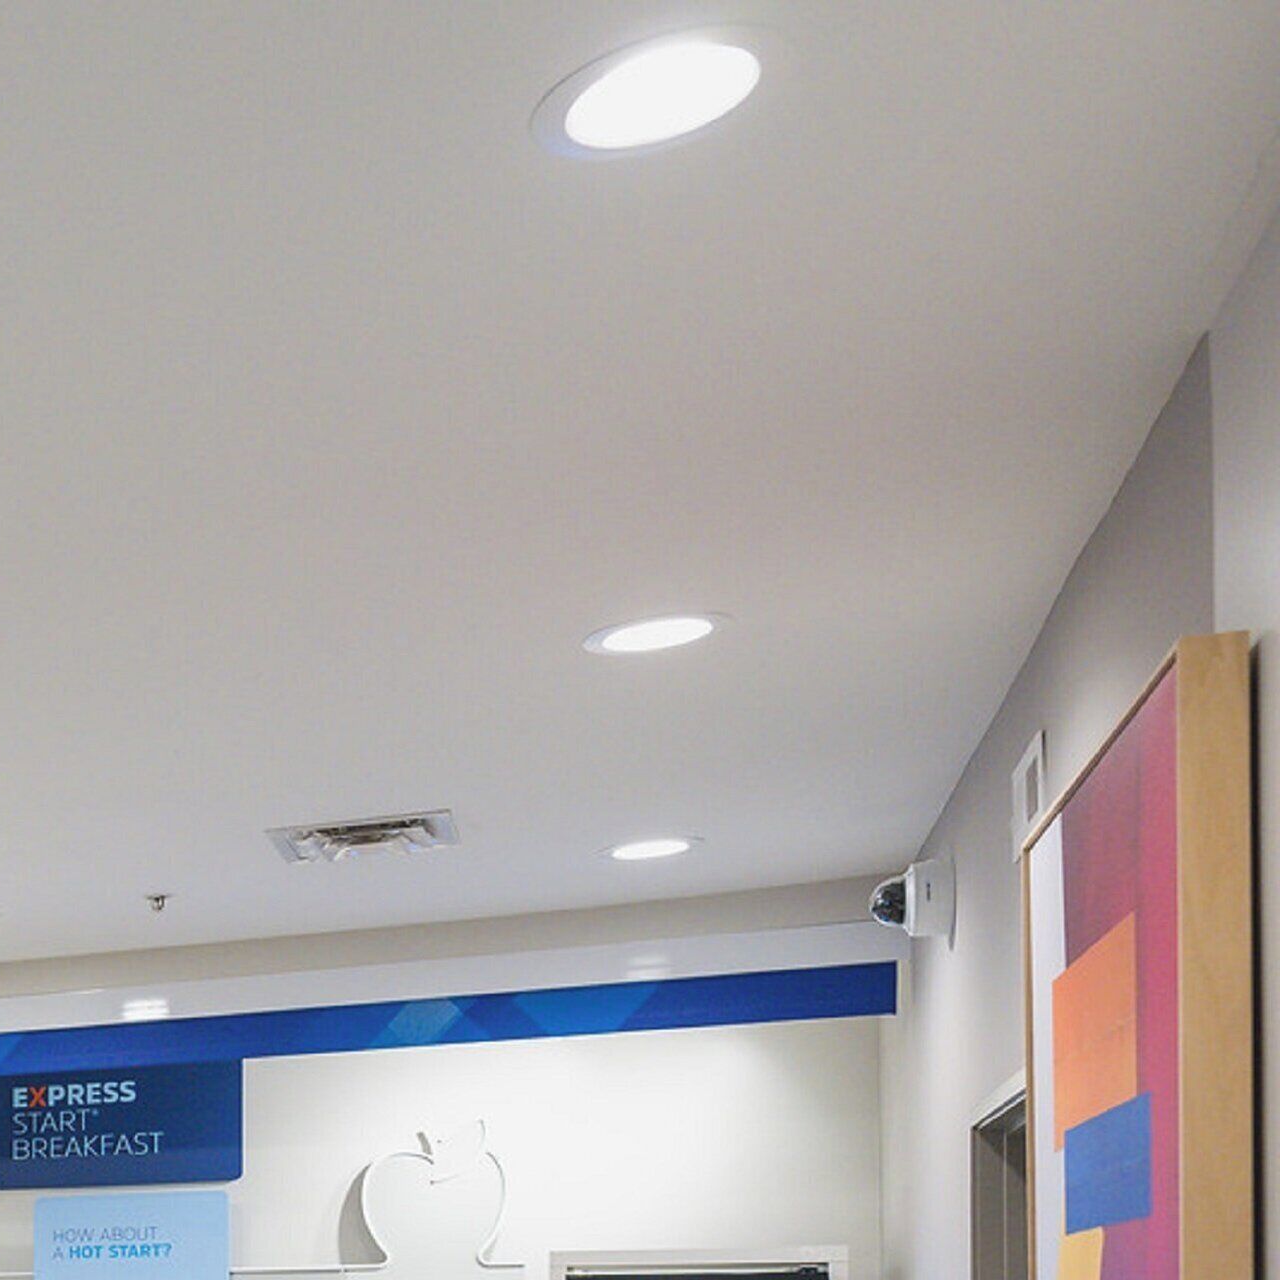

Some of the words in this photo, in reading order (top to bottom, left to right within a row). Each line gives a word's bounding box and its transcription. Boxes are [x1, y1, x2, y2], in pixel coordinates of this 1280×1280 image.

[11, 1080, 137, 1108] EXPRESS
[11, 1131, 165, 1161] BREAKFAST
[52, 1228, 94, 1243] HOW
[99, 1226, 159, 1242] ABOUT
[52, 1246, 65, 1260] A
[69, 1245, 104, 1259] HOT
[108, 1243, 172, 1259] START?
